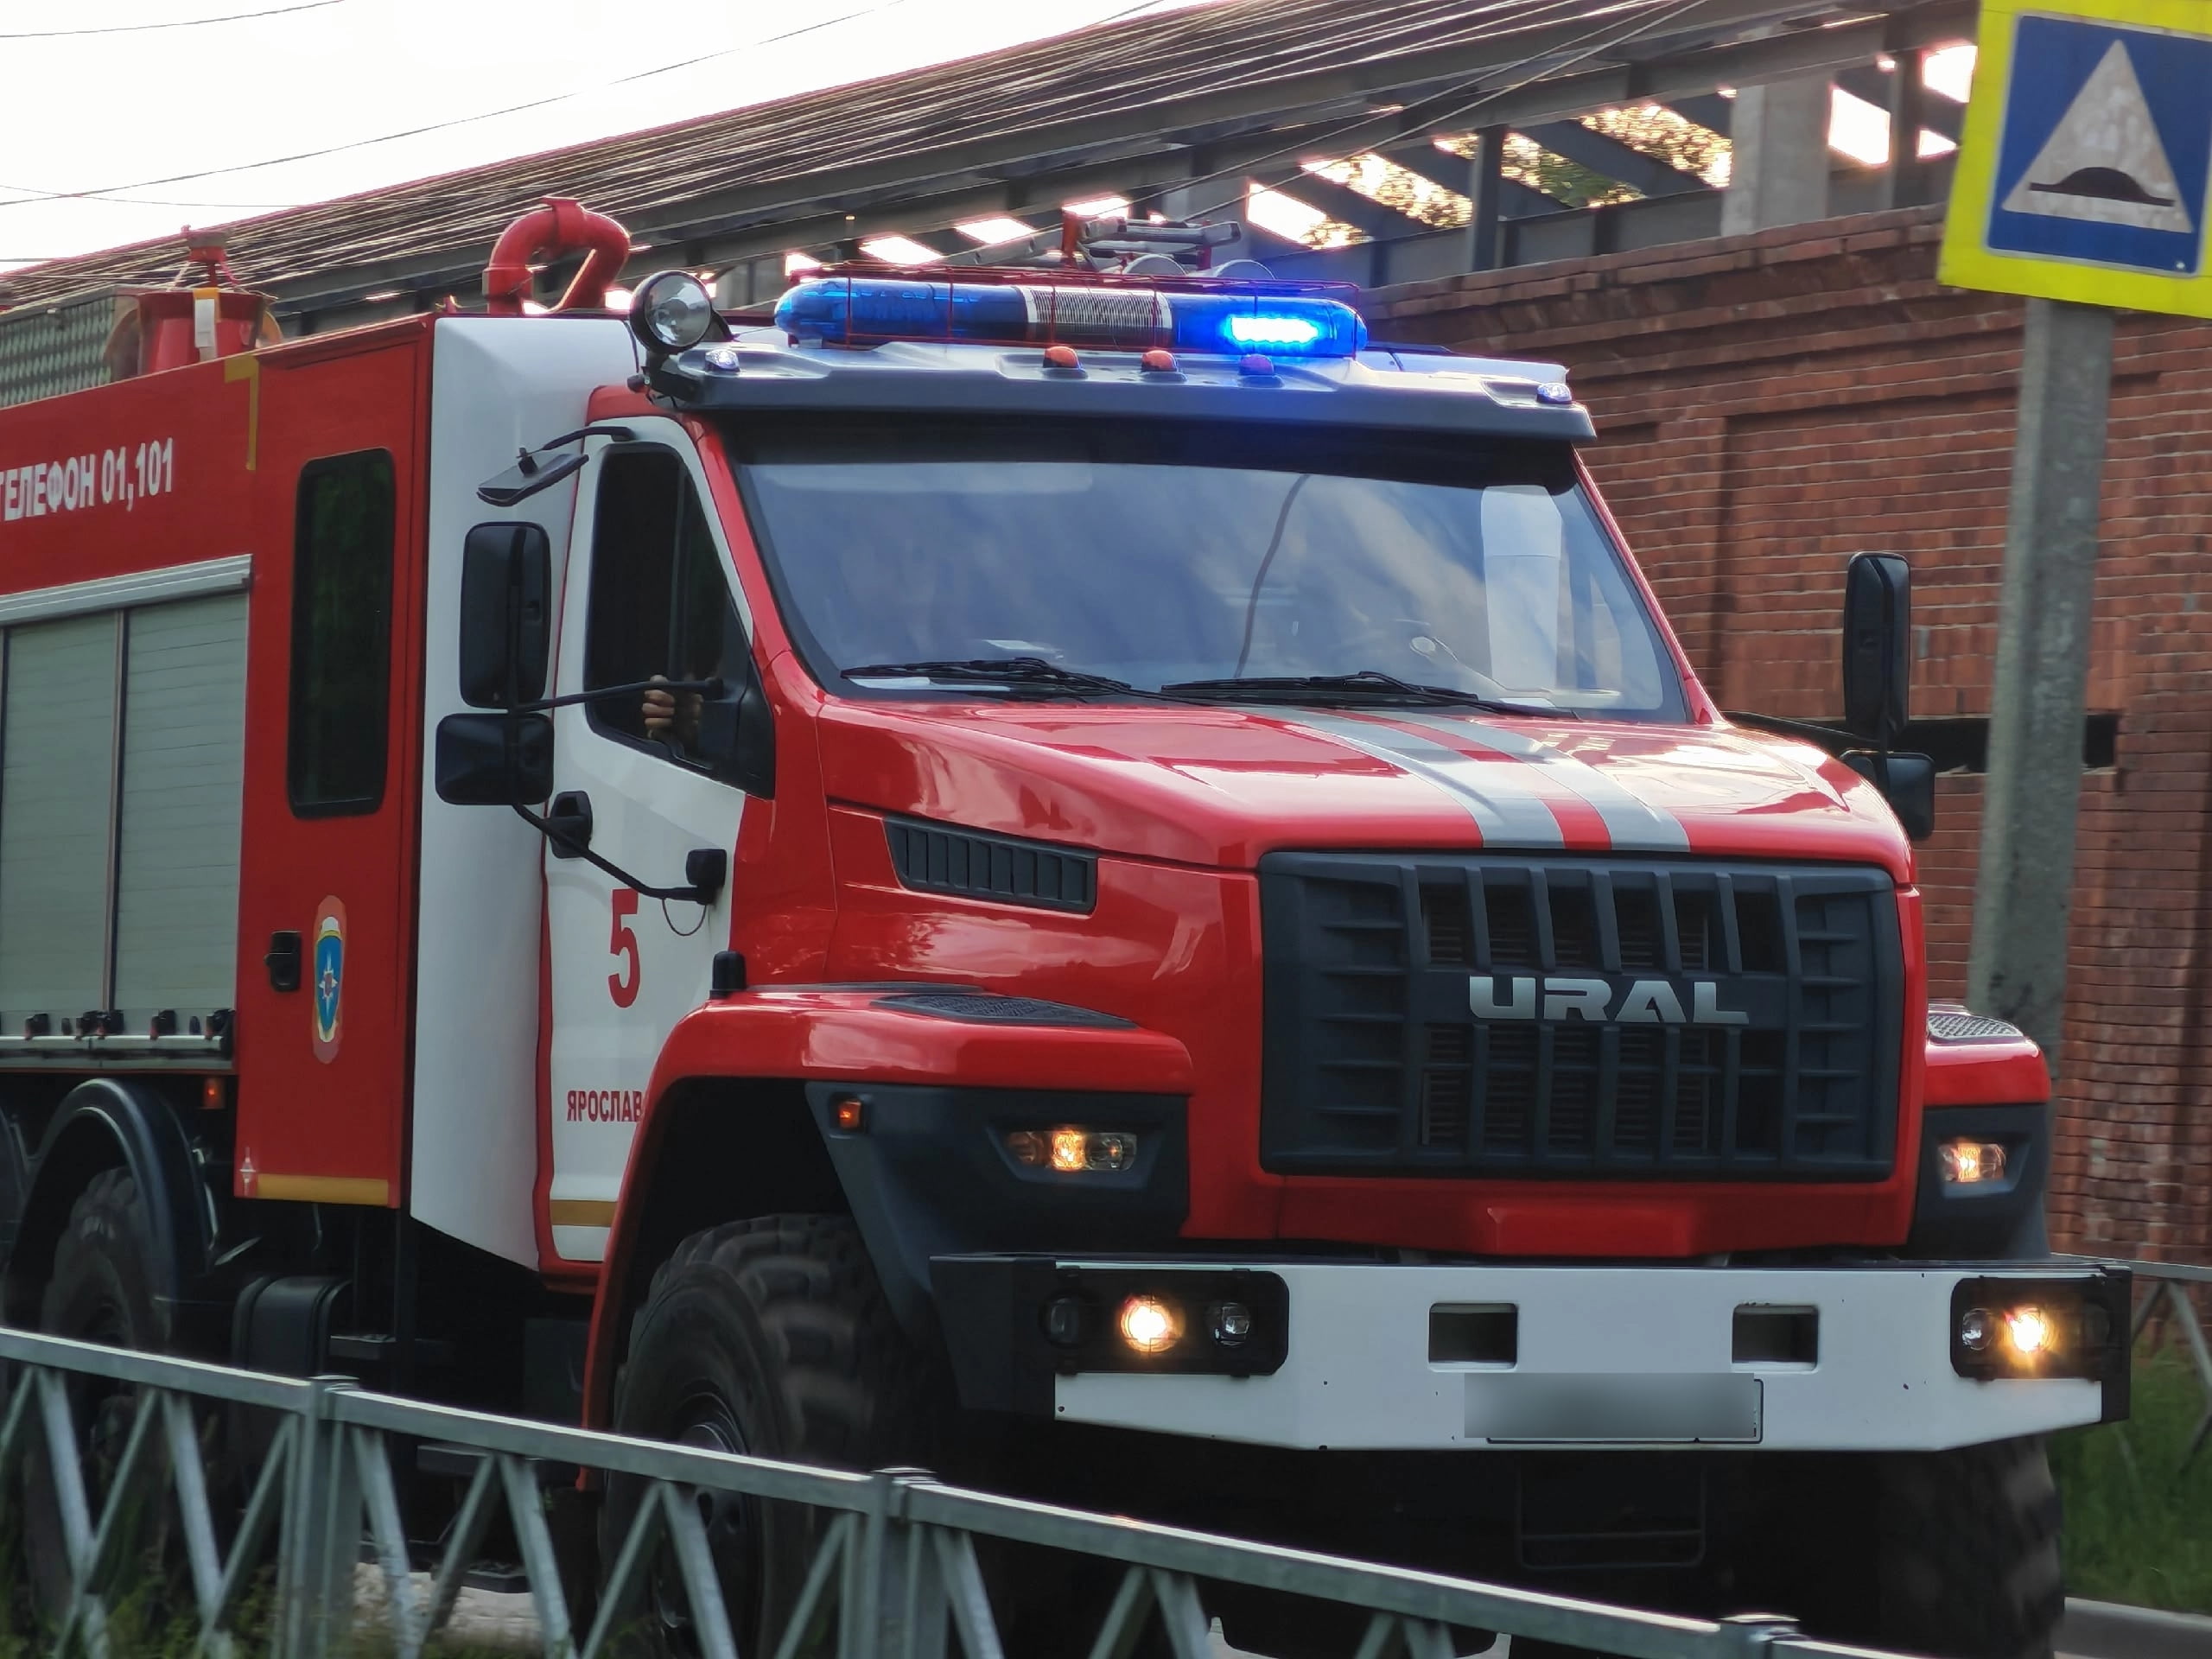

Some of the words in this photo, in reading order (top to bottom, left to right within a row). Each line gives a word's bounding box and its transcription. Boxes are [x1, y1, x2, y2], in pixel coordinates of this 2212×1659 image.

[0, 454, 95, 521] ЕЛЕФОН
[608, 888, 640, 1008] 5
[1469, 976, 1750, 1025] URAL
